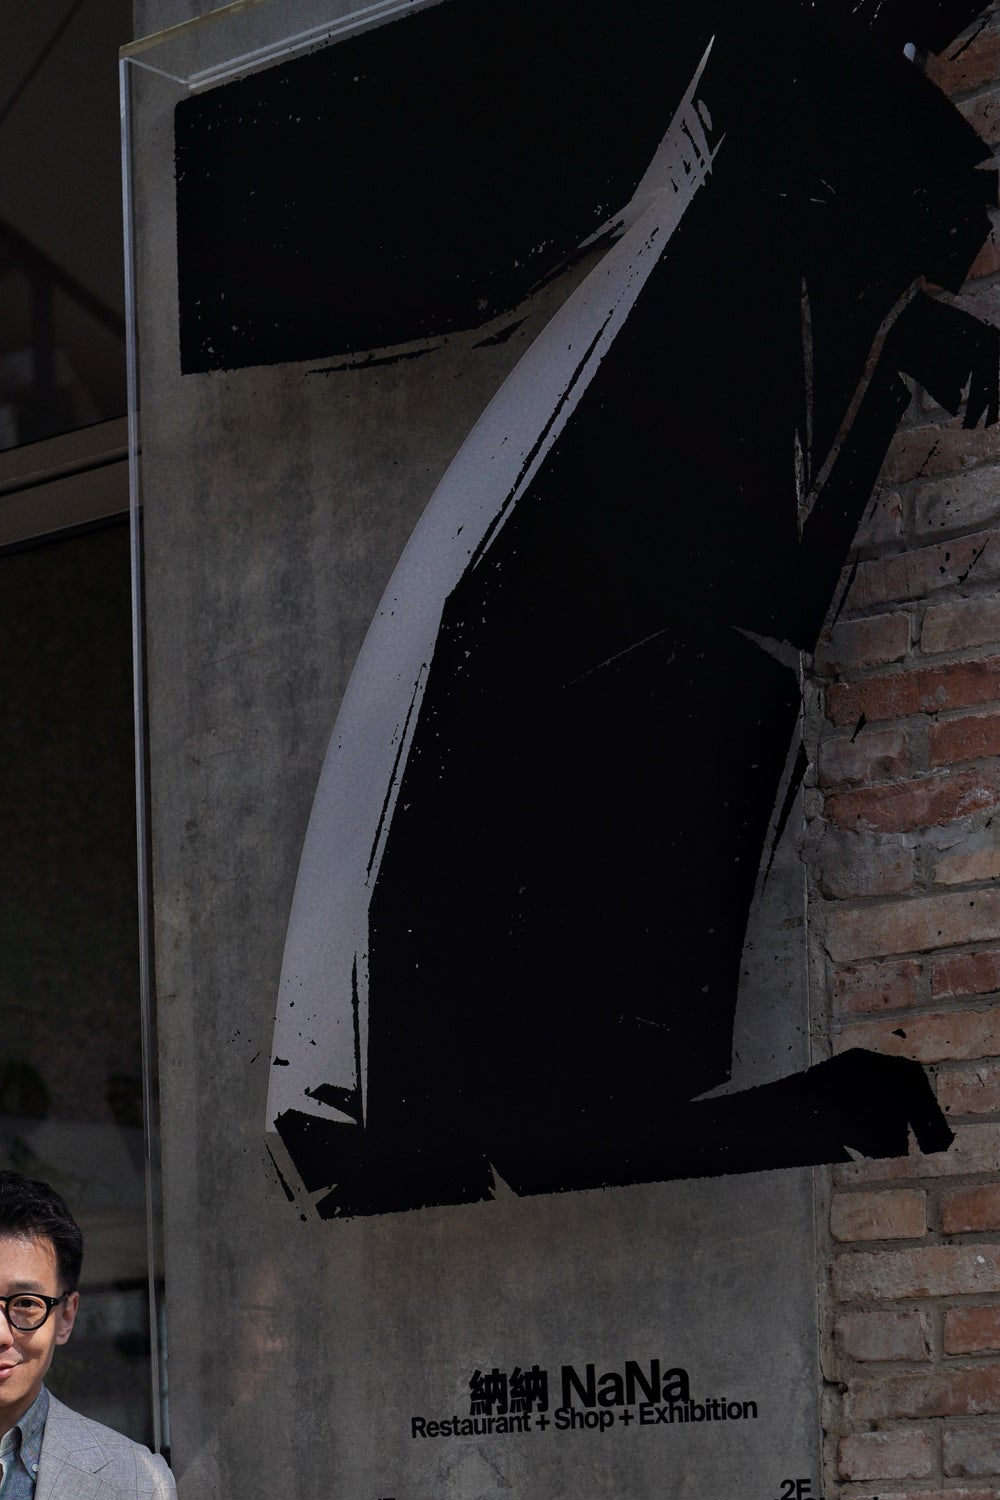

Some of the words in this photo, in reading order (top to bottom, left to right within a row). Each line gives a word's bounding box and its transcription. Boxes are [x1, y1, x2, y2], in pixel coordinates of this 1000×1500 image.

[561, 1359, 690, 1408] NaNa
[411, 1411, 531, 1438] Restaurant
[554, 1407, 614, 1432] Shop
[639, 1398, 758, 1425] Exhibition
